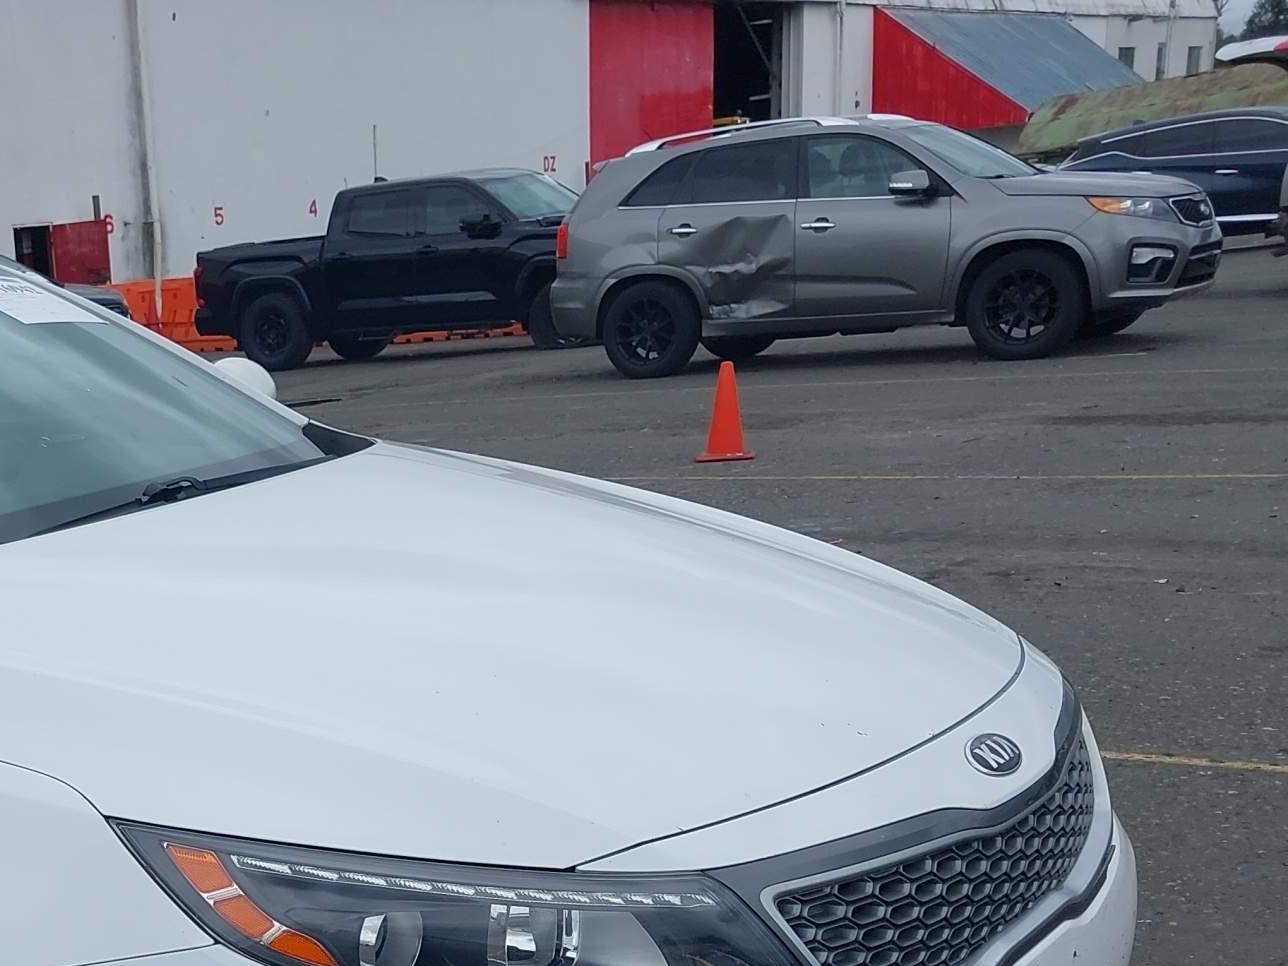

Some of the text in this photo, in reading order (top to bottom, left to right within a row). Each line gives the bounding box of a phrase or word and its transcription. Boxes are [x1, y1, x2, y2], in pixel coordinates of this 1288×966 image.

[213, 206, 225, 226] 5
[308, 199, 318, 217] 4
[103, 213, 115, 234] 6
